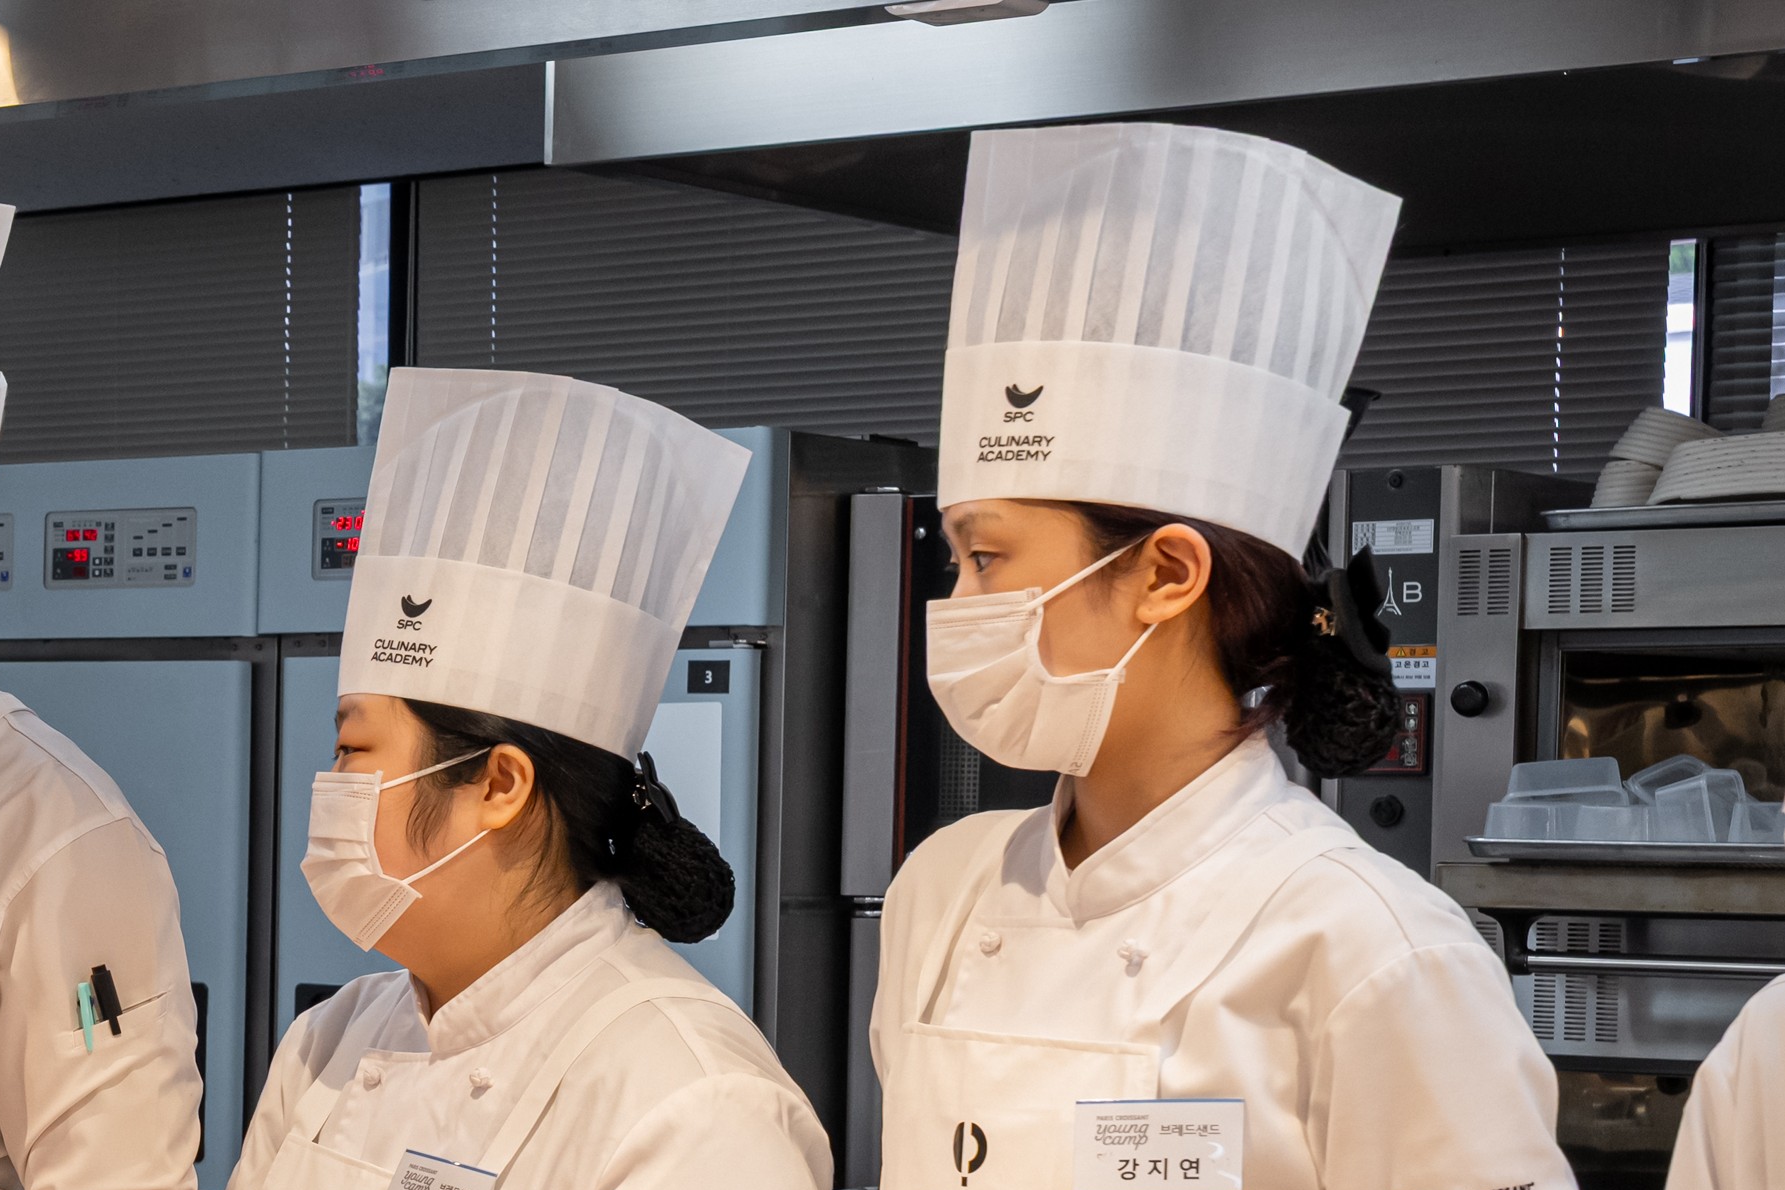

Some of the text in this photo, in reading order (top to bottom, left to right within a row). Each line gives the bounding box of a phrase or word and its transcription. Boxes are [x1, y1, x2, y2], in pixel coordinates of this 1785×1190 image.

[1003, 411, 1034, 422] SPC
[979, 435, 1055, 448] CULINARY
[976, 450, 1052, 463] ACADEMY
[1403, 581, 1422, 603] B
[396, 619, 422, 631] SPC
[374, 639, 437, 655] CULINARY
[371, 651, 434, 667] ACADEMY
[704, 670, 713, 684] 3
[1095, 1123, 1149, 1141] young
[1102, 1134, 1149, 1150] camp
[1117, 1158, 1200, 1181] 강지연
[401, 1170, 435, 1187] young
